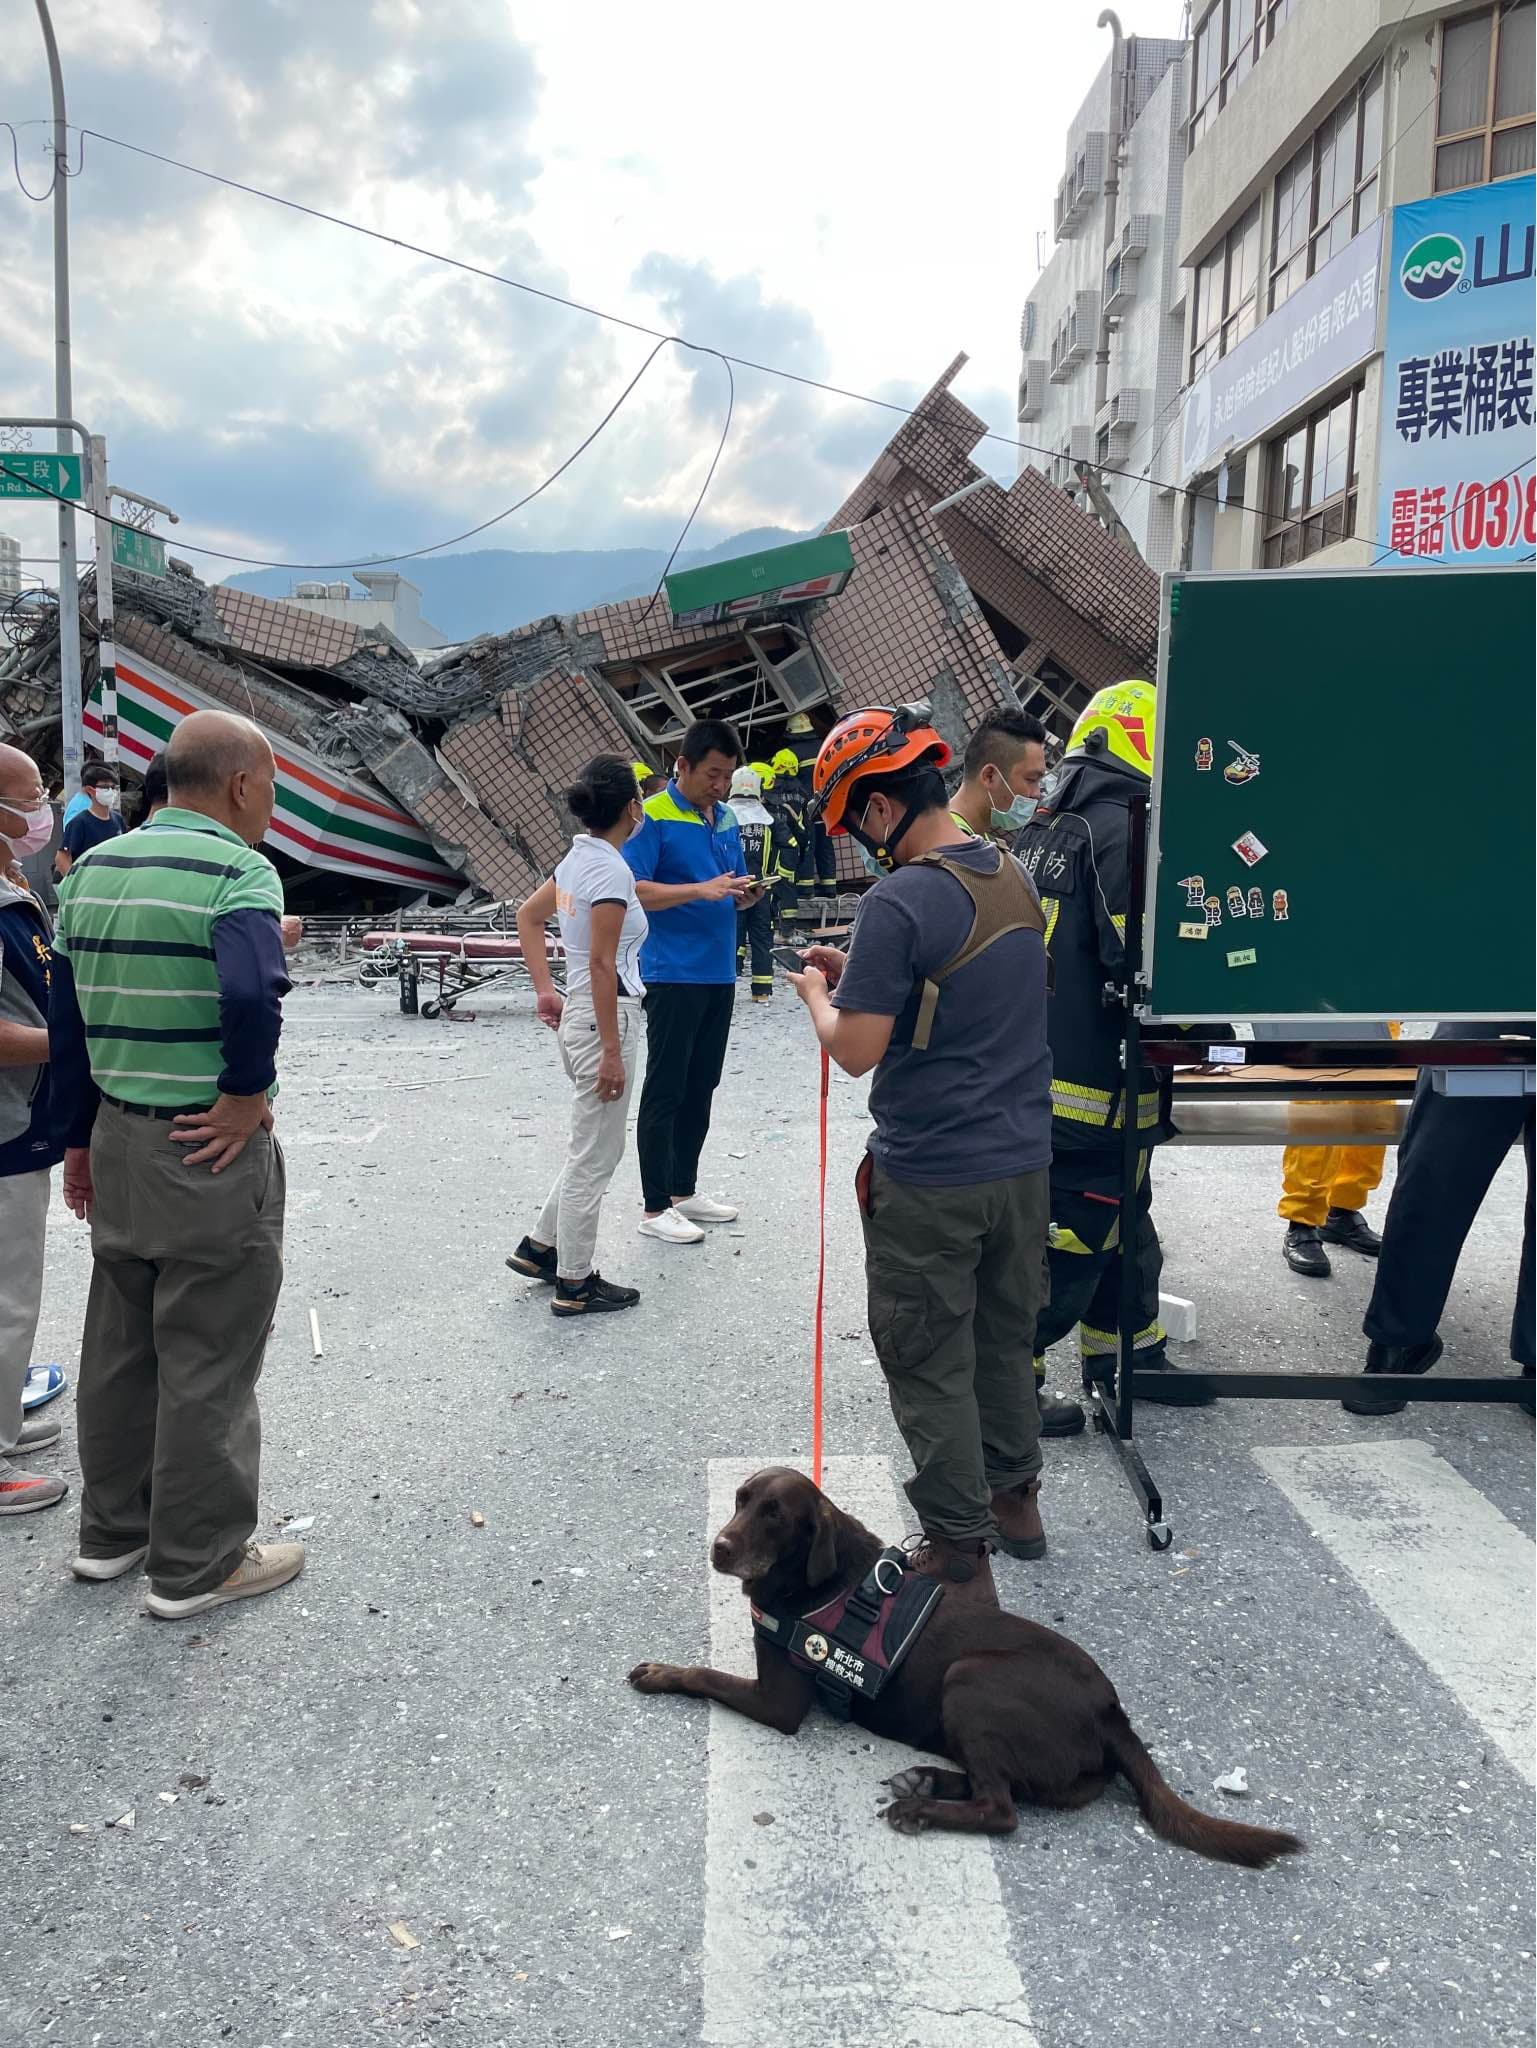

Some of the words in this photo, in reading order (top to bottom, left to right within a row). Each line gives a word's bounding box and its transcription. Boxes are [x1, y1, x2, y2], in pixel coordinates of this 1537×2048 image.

[825, 1657, 865, 1688] 搜救犬隊
[834, 1647, 865, 1672] 新北市
